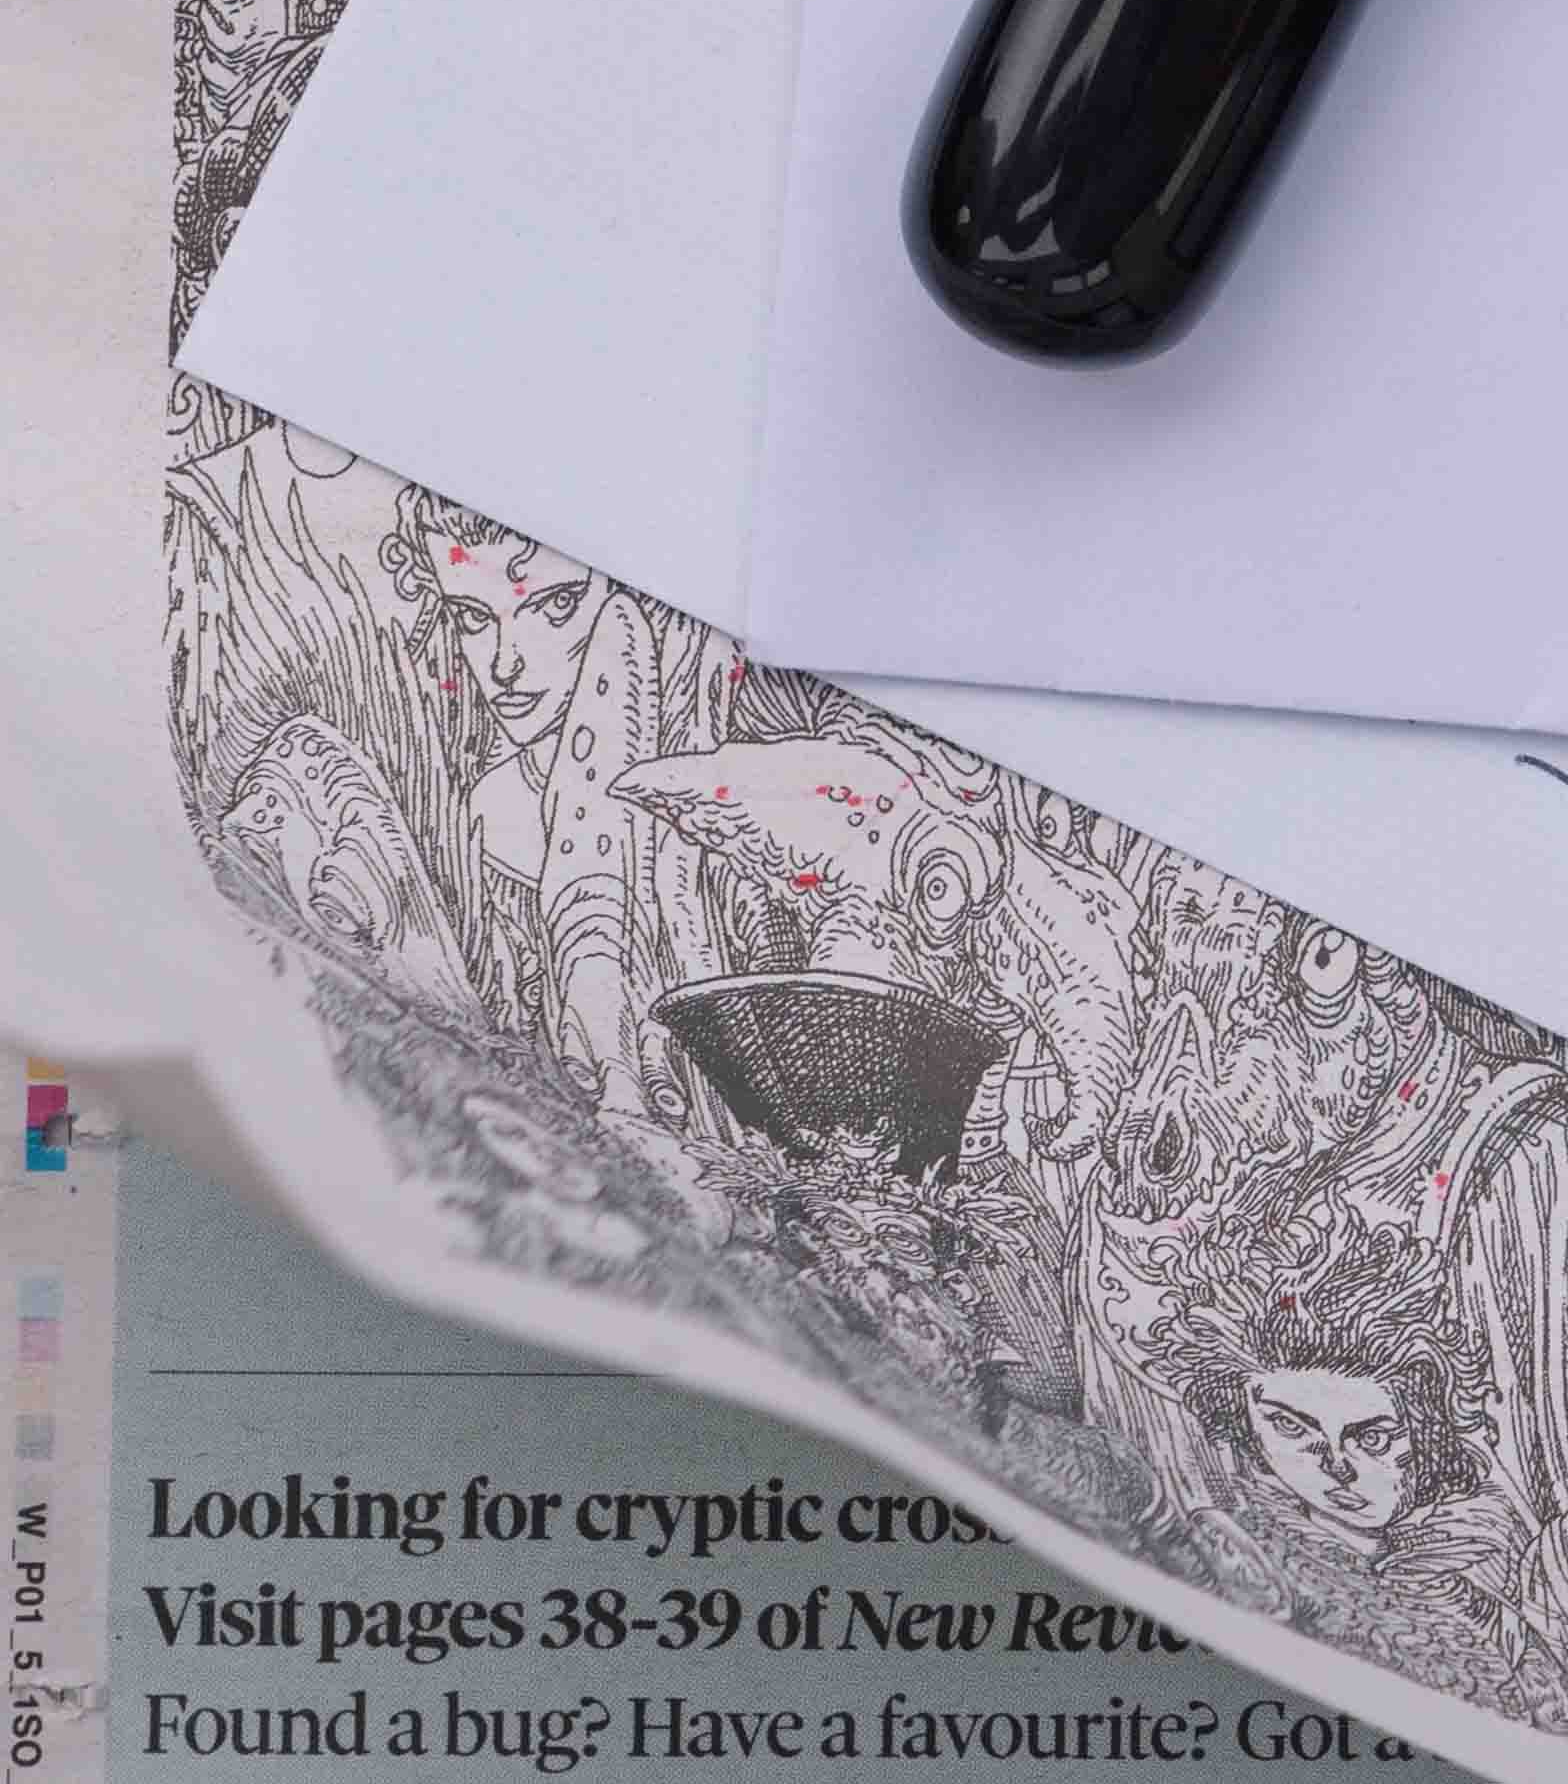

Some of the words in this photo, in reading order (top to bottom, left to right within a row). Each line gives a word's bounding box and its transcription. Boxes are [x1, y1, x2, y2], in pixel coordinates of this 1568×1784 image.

[146, 1473, 448, 1557] Looking
[459, 1474, 563, 1541] for
[574, 1474, 823, 1559] cryptic
[837, 1490, 1018, 1545] cros
[141, 1581, 306, 1649] Visit
[315, 1598, 527, 1665] pages
[539, 1587, 744, 1652] 38-39
[756, 1583, 832, 1652] of
[842, 1589, 998, 1653] New
[142, 1688, 372, 1758] Found
[386, 1705, 429, 1758] a
[442, 1689, 612, 1775] bug?
[627, 1696, 802, 1760] Have
[819, 1708, 862, 1759] a
[876, 1691, 1220, 1762] favourite?
[1236, 1698, 1363, 1763] Got
